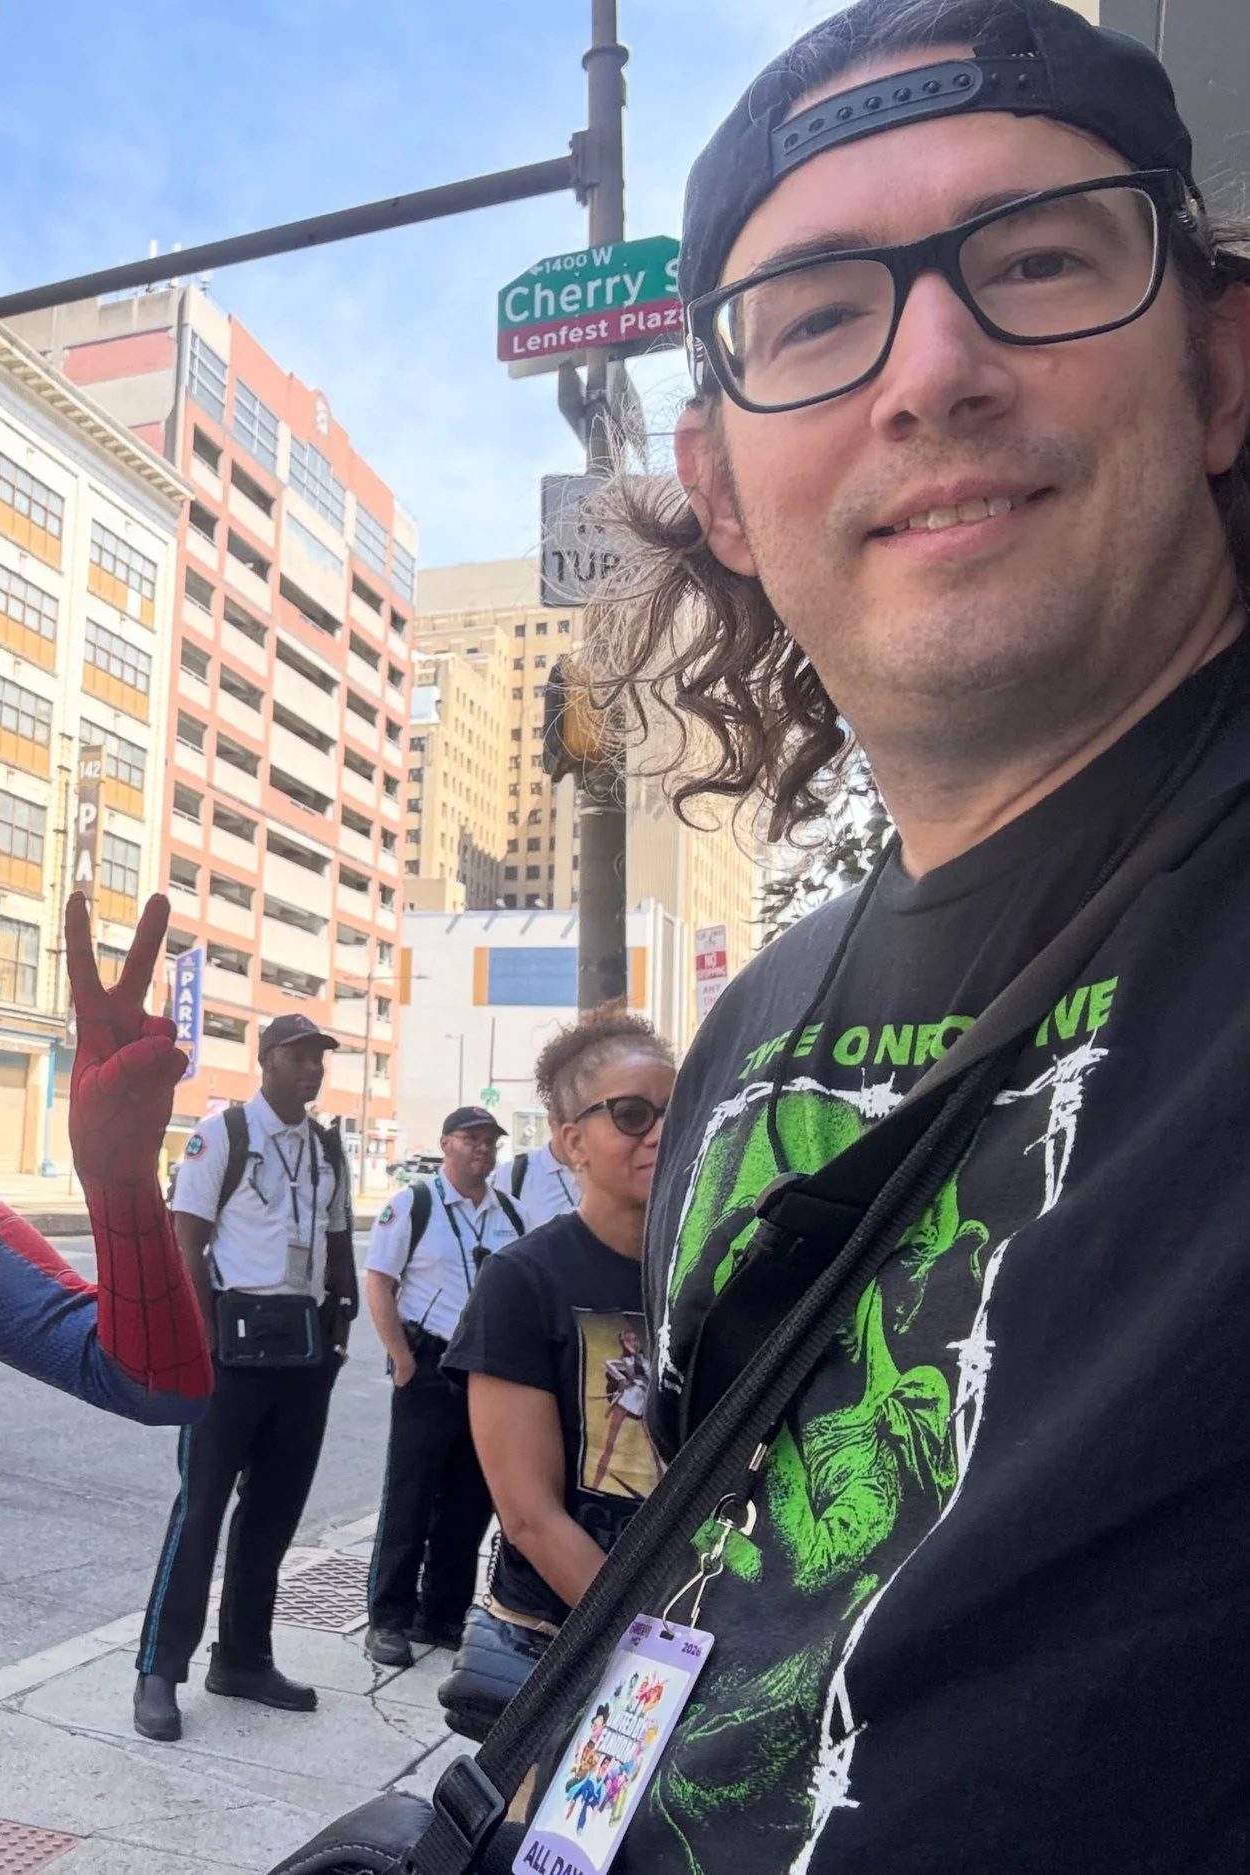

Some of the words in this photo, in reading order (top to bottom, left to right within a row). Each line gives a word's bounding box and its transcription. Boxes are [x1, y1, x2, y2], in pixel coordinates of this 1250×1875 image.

[544, 253, 588, 275] 1400
[591, 245, 614, 267] W
[505, 270, 647, 323] Cherry
[664, 257, 681, 293] S
[512, 319, 609, 354] Lenfest
[551, 550, 621, 583] TUR
[79, 759, 102, 779] 142
[176, 970, 195, 1040] PARK
[523, 1840, 551, 1875] ALL
